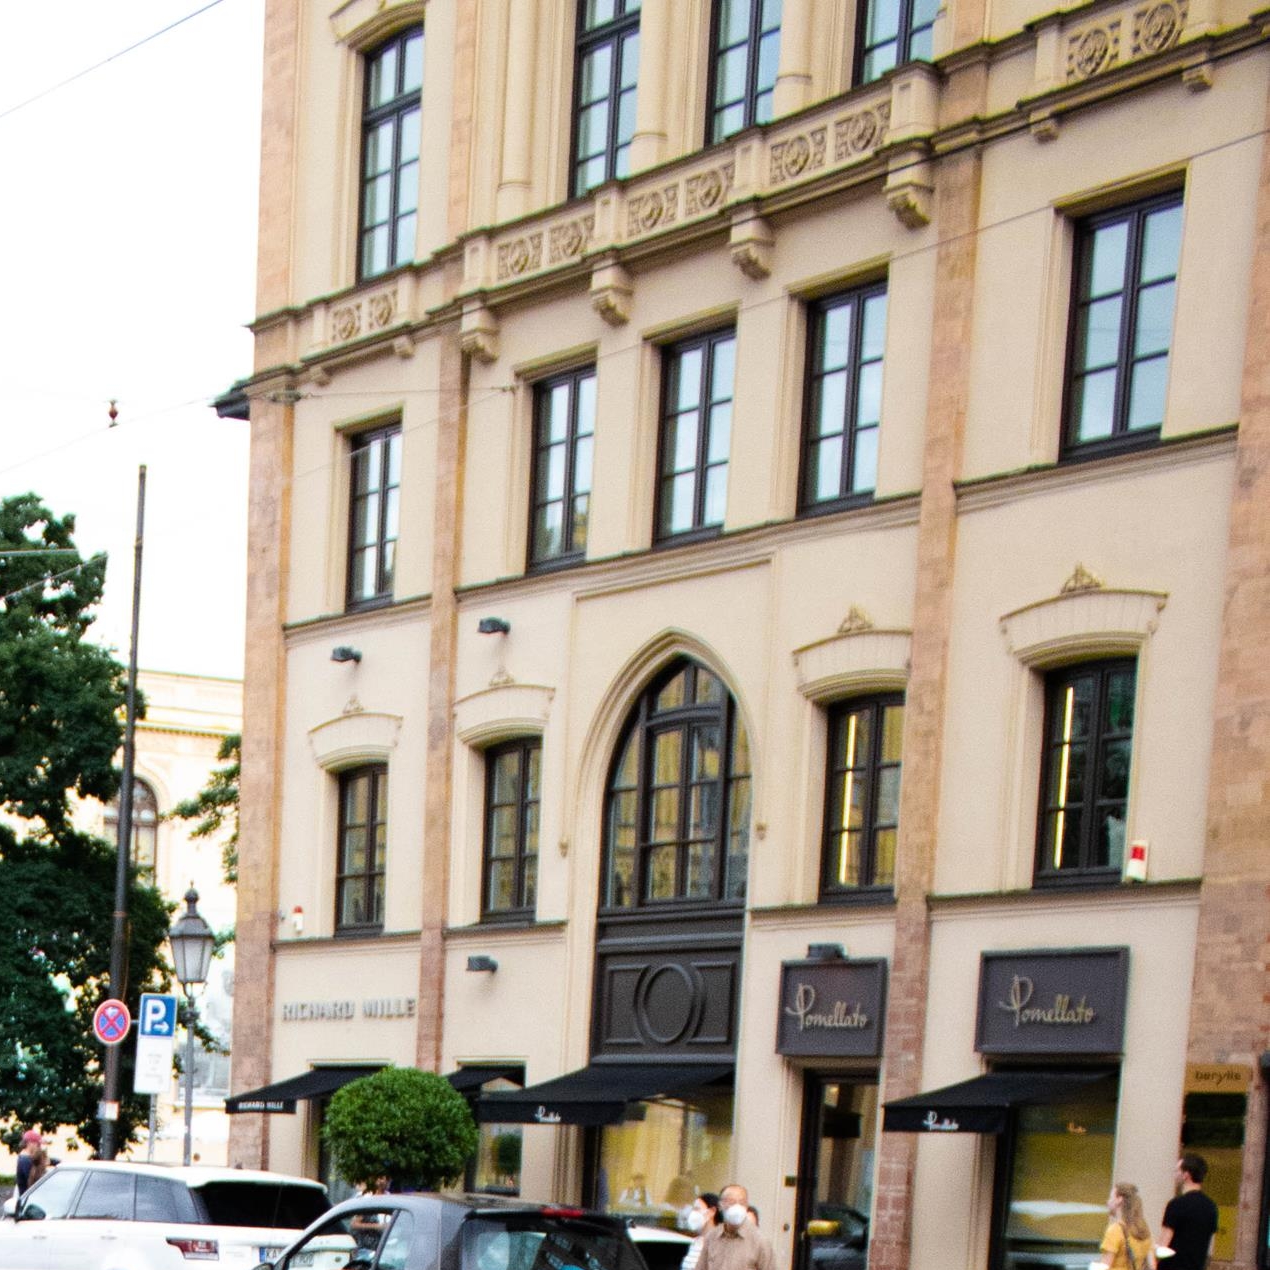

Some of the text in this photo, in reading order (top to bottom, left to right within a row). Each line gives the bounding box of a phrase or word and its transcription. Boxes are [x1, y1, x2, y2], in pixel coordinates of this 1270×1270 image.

[144, 999, 167, 1033] P
[283, 999, 415, 1020] RICHARD MILLE
[785, 983, 868, 1030] Pomellato
[997, 975, 1094, 1027] Pomellato
